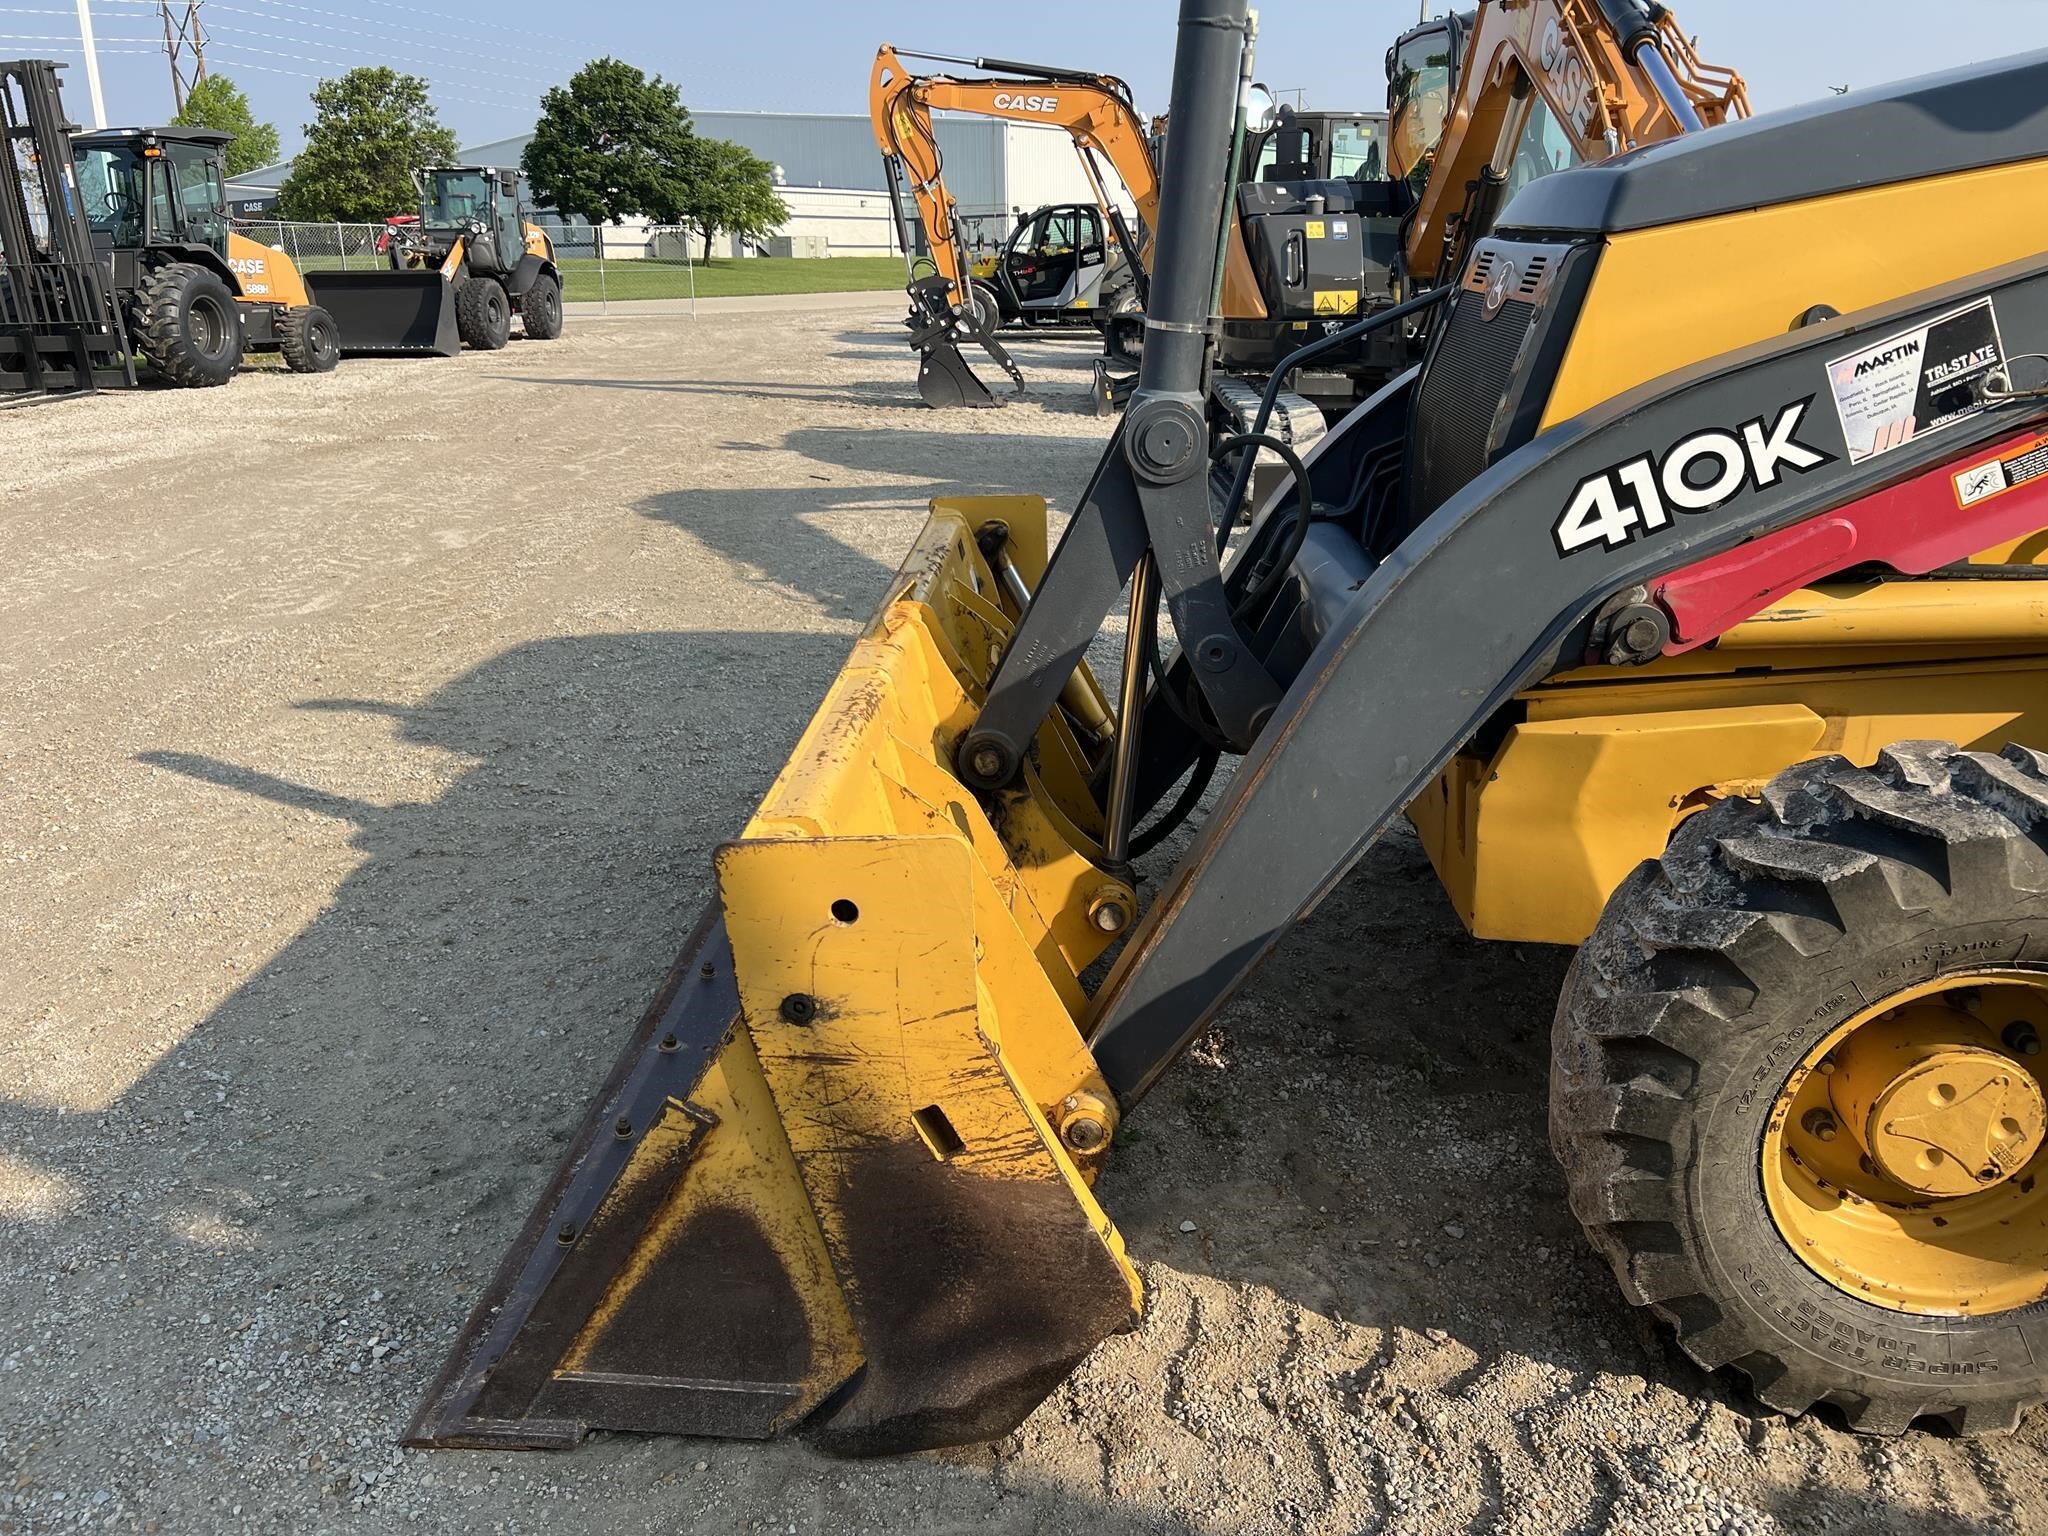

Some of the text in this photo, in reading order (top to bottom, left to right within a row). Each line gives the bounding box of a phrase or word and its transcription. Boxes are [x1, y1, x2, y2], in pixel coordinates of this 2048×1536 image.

[1541, 17, 1594, 140] CASE
[993, 93, 1059, 113] CASE
[243, 202, 263, 212] CASE
[227, 258, 264, 274] CASE
[1854, 339, 1919, 378] MARTIN
[1924, 344, 1996, 382] TRI-STATE
[1555, 400, 1830, 554] 410K
[1738, 1263, 1999, 1375] SUPER TRACTION
[1797, 1298, 1917, 1355] LOADER
